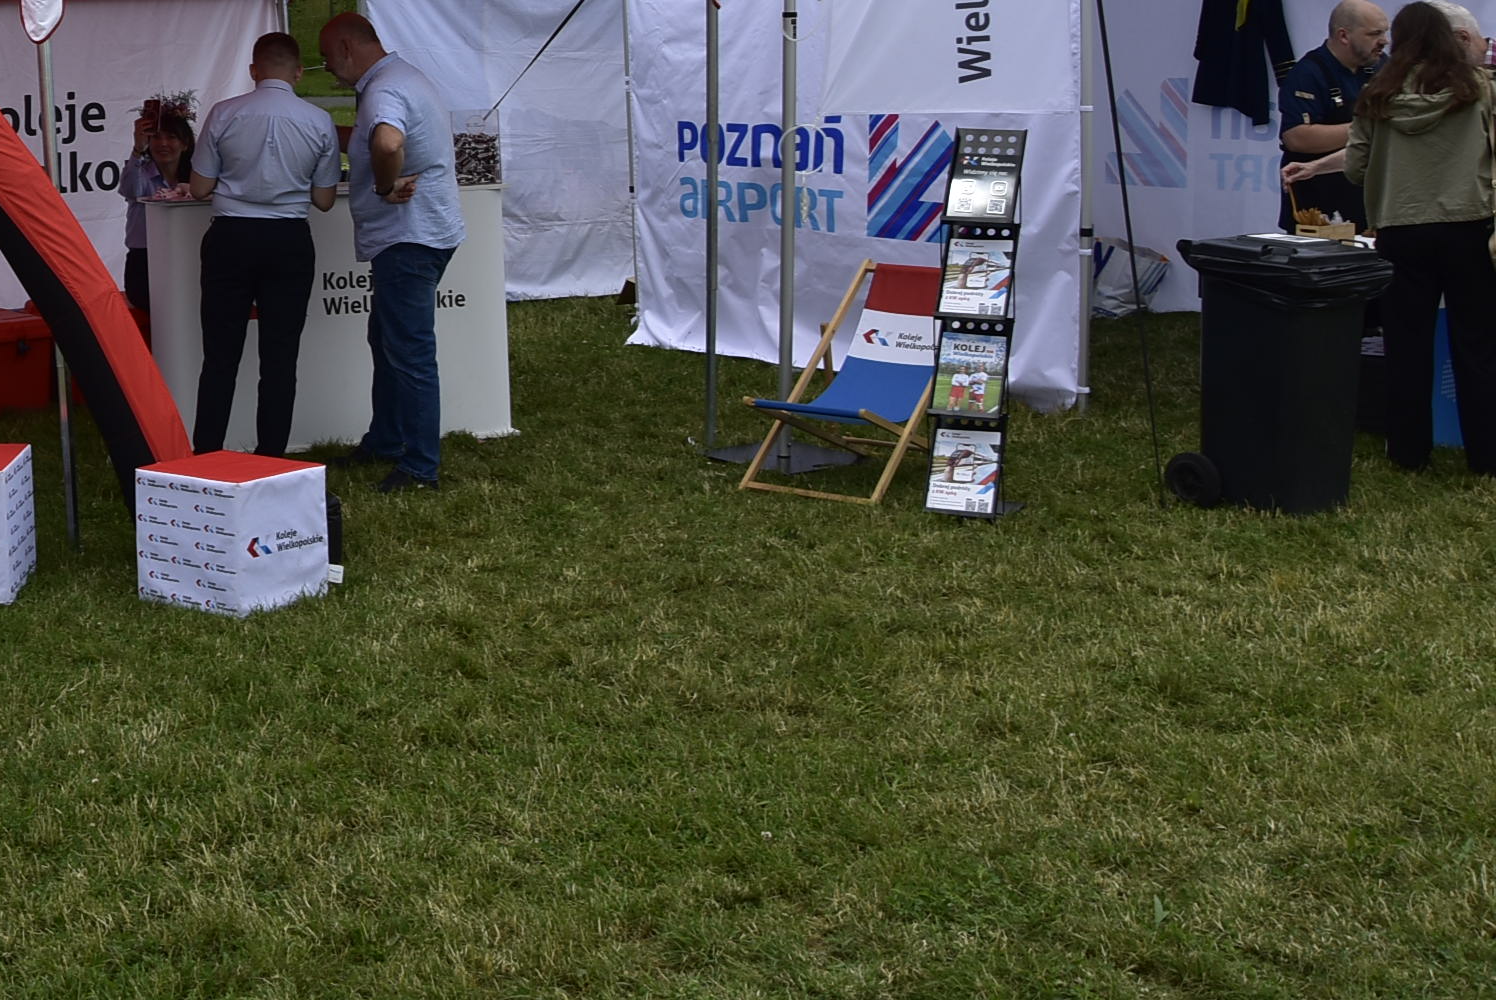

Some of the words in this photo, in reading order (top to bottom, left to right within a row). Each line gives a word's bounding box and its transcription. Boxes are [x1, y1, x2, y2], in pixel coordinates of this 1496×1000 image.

[0, 91, 106, 144] olje
[322, 269, 373, 292] Kolej
[953, 343, 986, 353] KOLEJ
[275, 528, 298, 541] Koleje
[276, 533, 324, 552] Wielkopolskie
